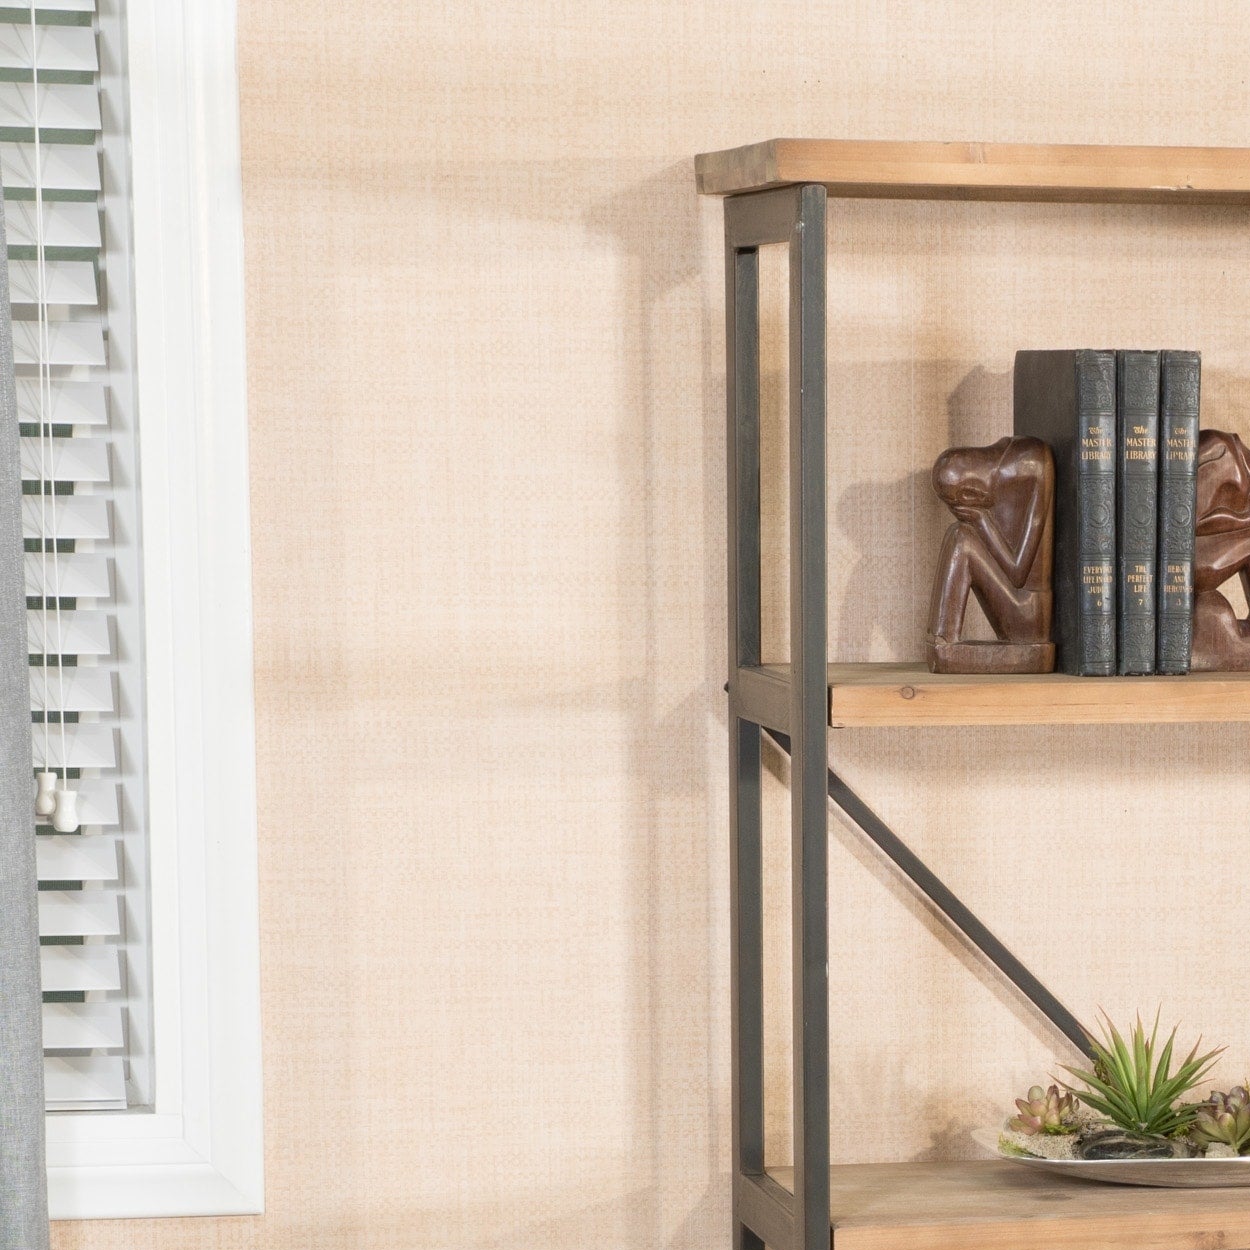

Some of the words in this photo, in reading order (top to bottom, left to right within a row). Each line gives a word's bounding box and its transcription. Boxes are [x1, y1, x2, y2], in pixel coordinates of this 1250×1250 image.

[1081, 438, 1112, 447] MASTER
[1126, 437, 1156, 447] MASTER
[1081, 451, 1111, 460] LIBRARY
[1126, 450, 1156, 460] LIBRARY
